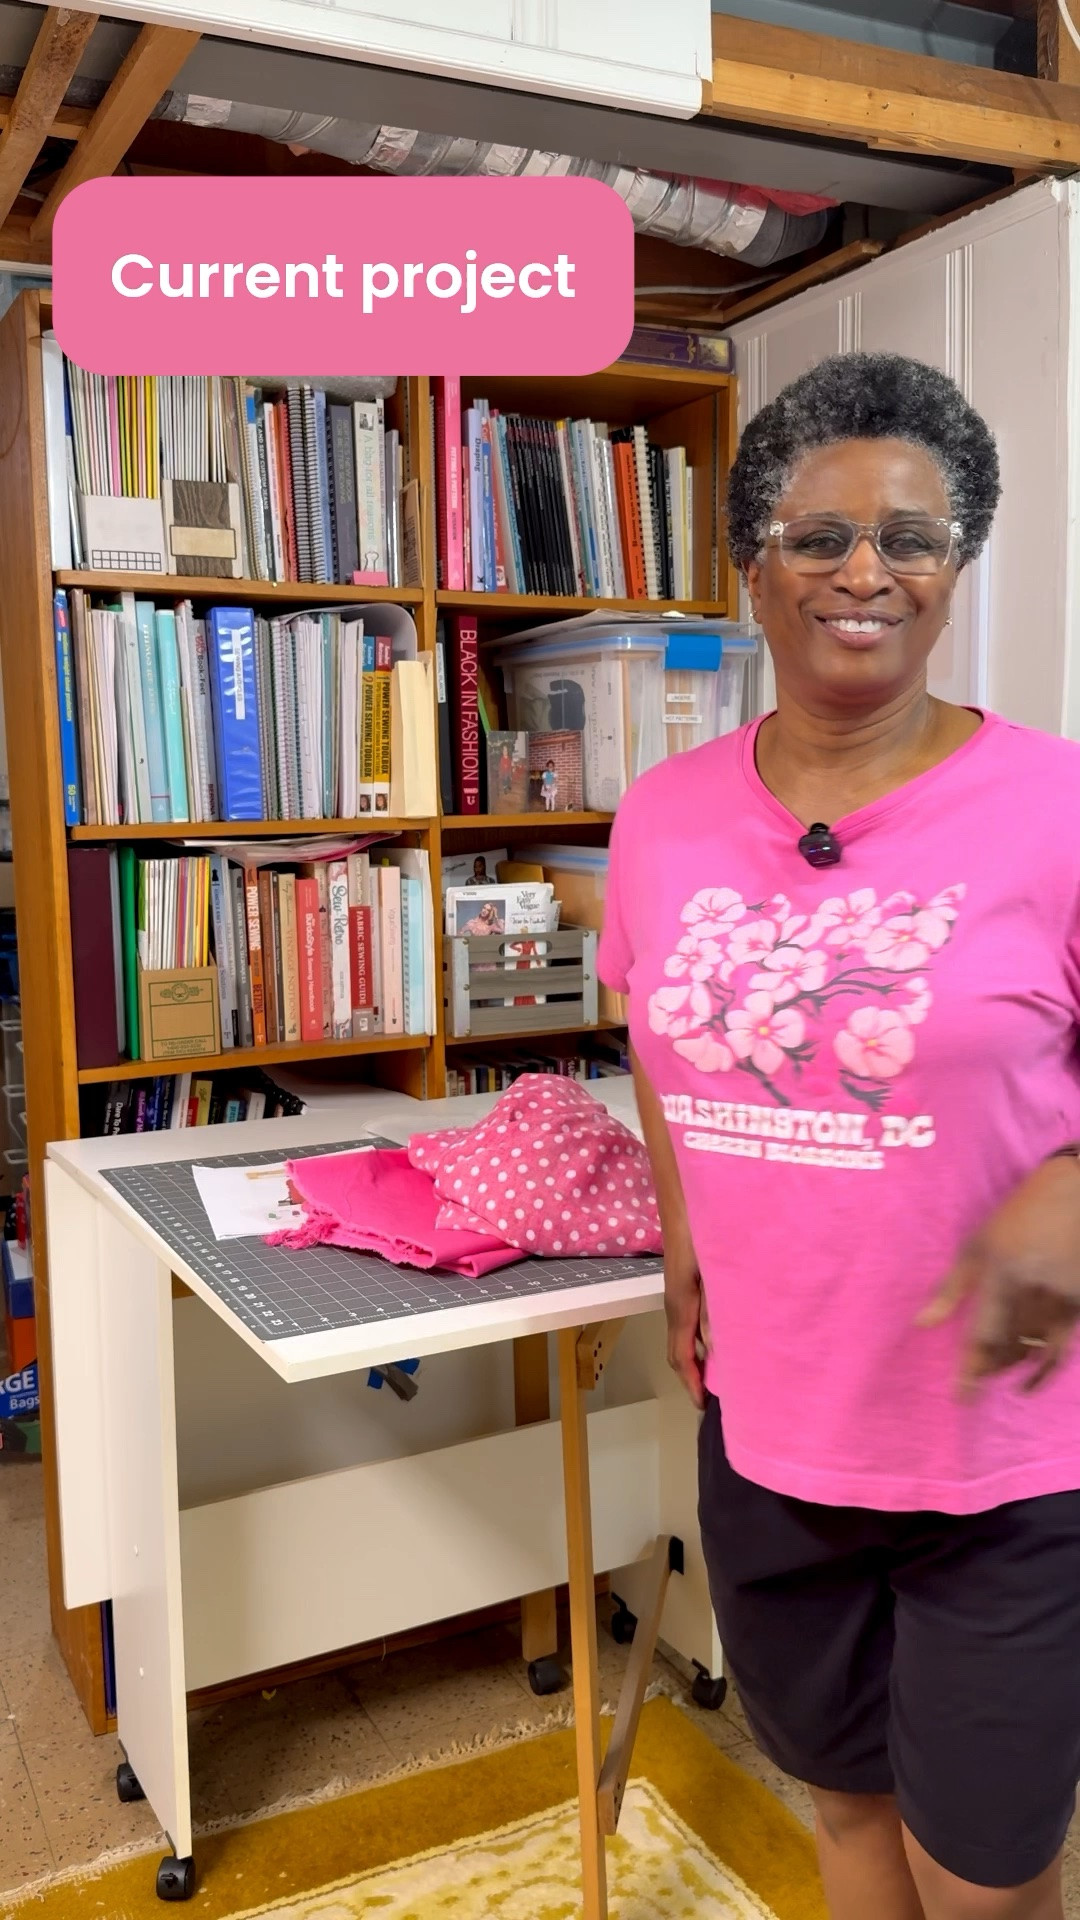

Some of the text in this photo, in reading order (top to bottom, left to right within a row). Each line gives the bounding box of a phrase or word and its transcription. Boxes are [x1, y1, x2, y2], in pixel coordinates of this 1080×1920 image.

[364, 434, 374, 443] A
[472, 438, 482, 472] Draping
[260, 460, 268, 487] CUSTOM
[366, 468, 376, 482] for
[366, 485, 375, 498] all
[366, 501, 376, 540] reasons
[364, 684, 372, 712] POWER
[382, 682, 390, 709] POWER
[460, 629, 478, 780] BLACK IN FASHION
[364, 712, 372, 742] SEWING
[382, 710, 390, 740] SEWING
[364, 744, 372, 778] TOOLBOX
[382, 742, 390, 774] TOOLBOX
[208, 784, 216, 816] BERNINA
[246, 886, 260, 918] POWER
[520, 902, 540, 911] Vogue
[521, 890, 536, 899] Very
[332, 885, 348, 945] Sew Retro
[248, 918, 261, 951] SEWING
[306, 958, 314, 980] Sewing
[356, 910, 366, 1005] FABRIC SEWING GUIDE
[253, 984, 263, 1014] BETZINA
[288, 976, 296, 1020] NOTIONS
[114, 1118, 122, 1126] To
[115, 1102, 124, 1118] Dare
[880, 1115, 936, 1148] DC
[10, 1395, 40, 1411] Bags
